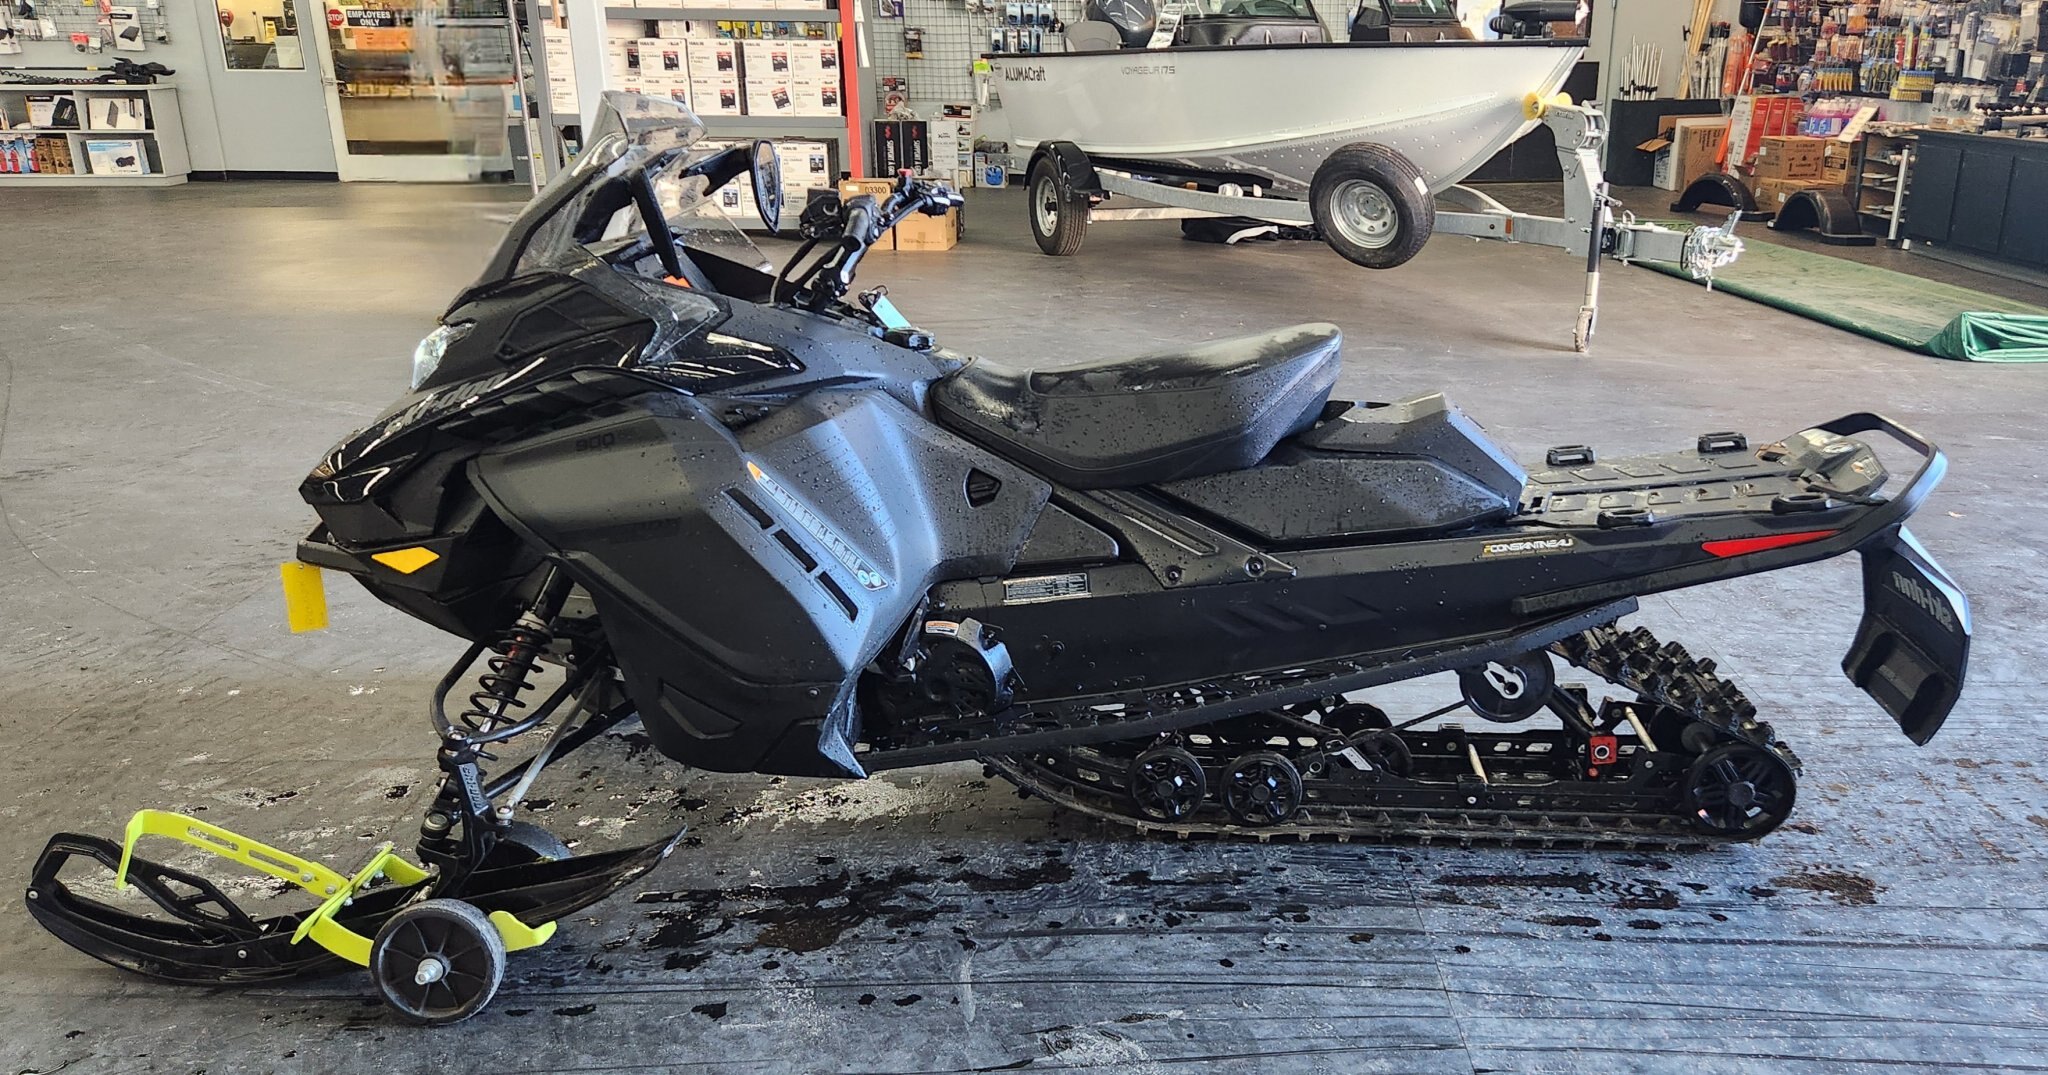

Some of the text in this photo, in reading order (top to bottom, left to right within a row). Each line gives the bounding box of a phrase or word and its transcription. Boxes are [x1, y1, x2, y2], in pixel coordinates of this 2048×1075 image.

[328, 13, 344, 21] STOP
[347, 10, 391, 19] EMPLOYEES
[1005, 65, 1046, 81] ALUMACraft
[1120, 65, 1176, 75] VOYAGEUR 175
[886, 139, 895, 161] SUPPORT
[913, 139, 921, 161] SUPPORT
[864, 186, 887, 194] 03300
[575, 432, 615, 451] 900
